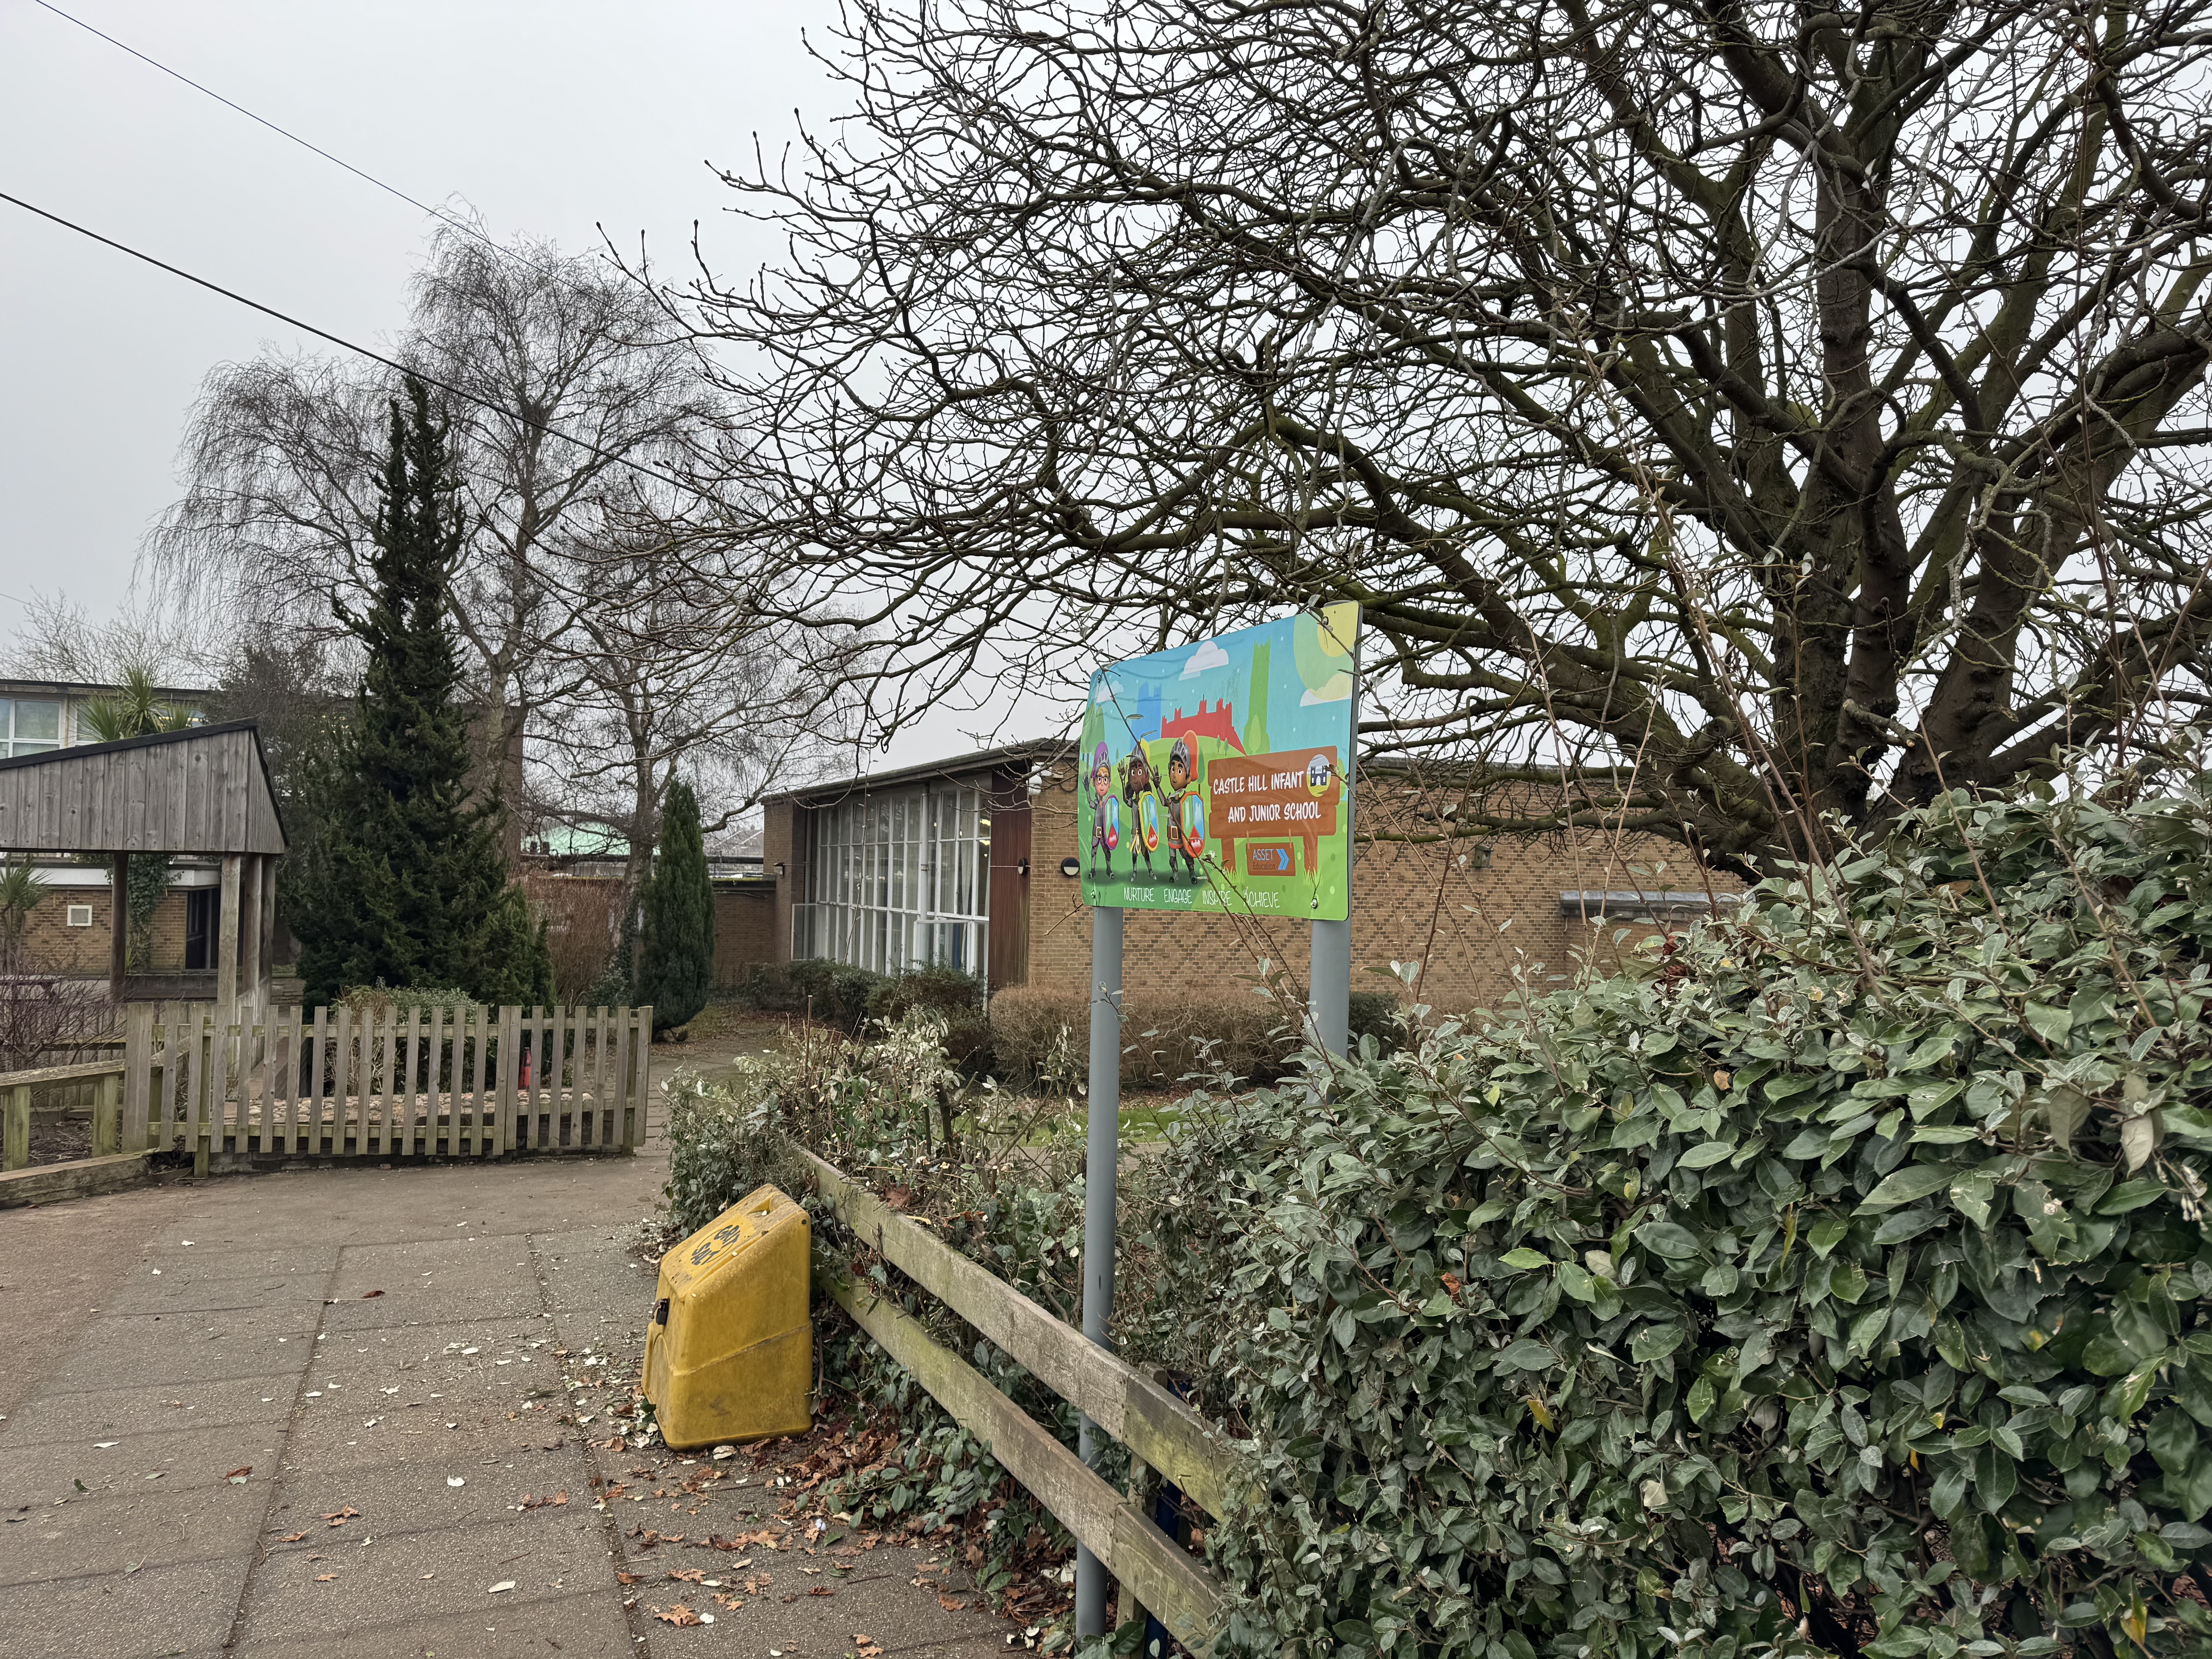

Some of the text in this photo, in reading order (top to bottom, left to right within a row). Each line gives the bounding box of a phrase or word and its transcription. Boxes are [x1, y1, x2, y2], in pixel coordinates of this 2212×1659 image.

[1213, 771, 1304, 795] CASTLE HILL INFANT
[1228, 801, 1321, 823] AND JUNIOR SCHOOL
[1253, 849, 1274, 860] ASSET
[1124, 887, 1155, 902] NURTURE
[1164, 888, 1192, 904] ENGAGE
[1202, 890, 1232, 905] INSPIRE
[713, 1224, 740, 1249] GRIT
[690, 1242, 721, 1266] SALT
